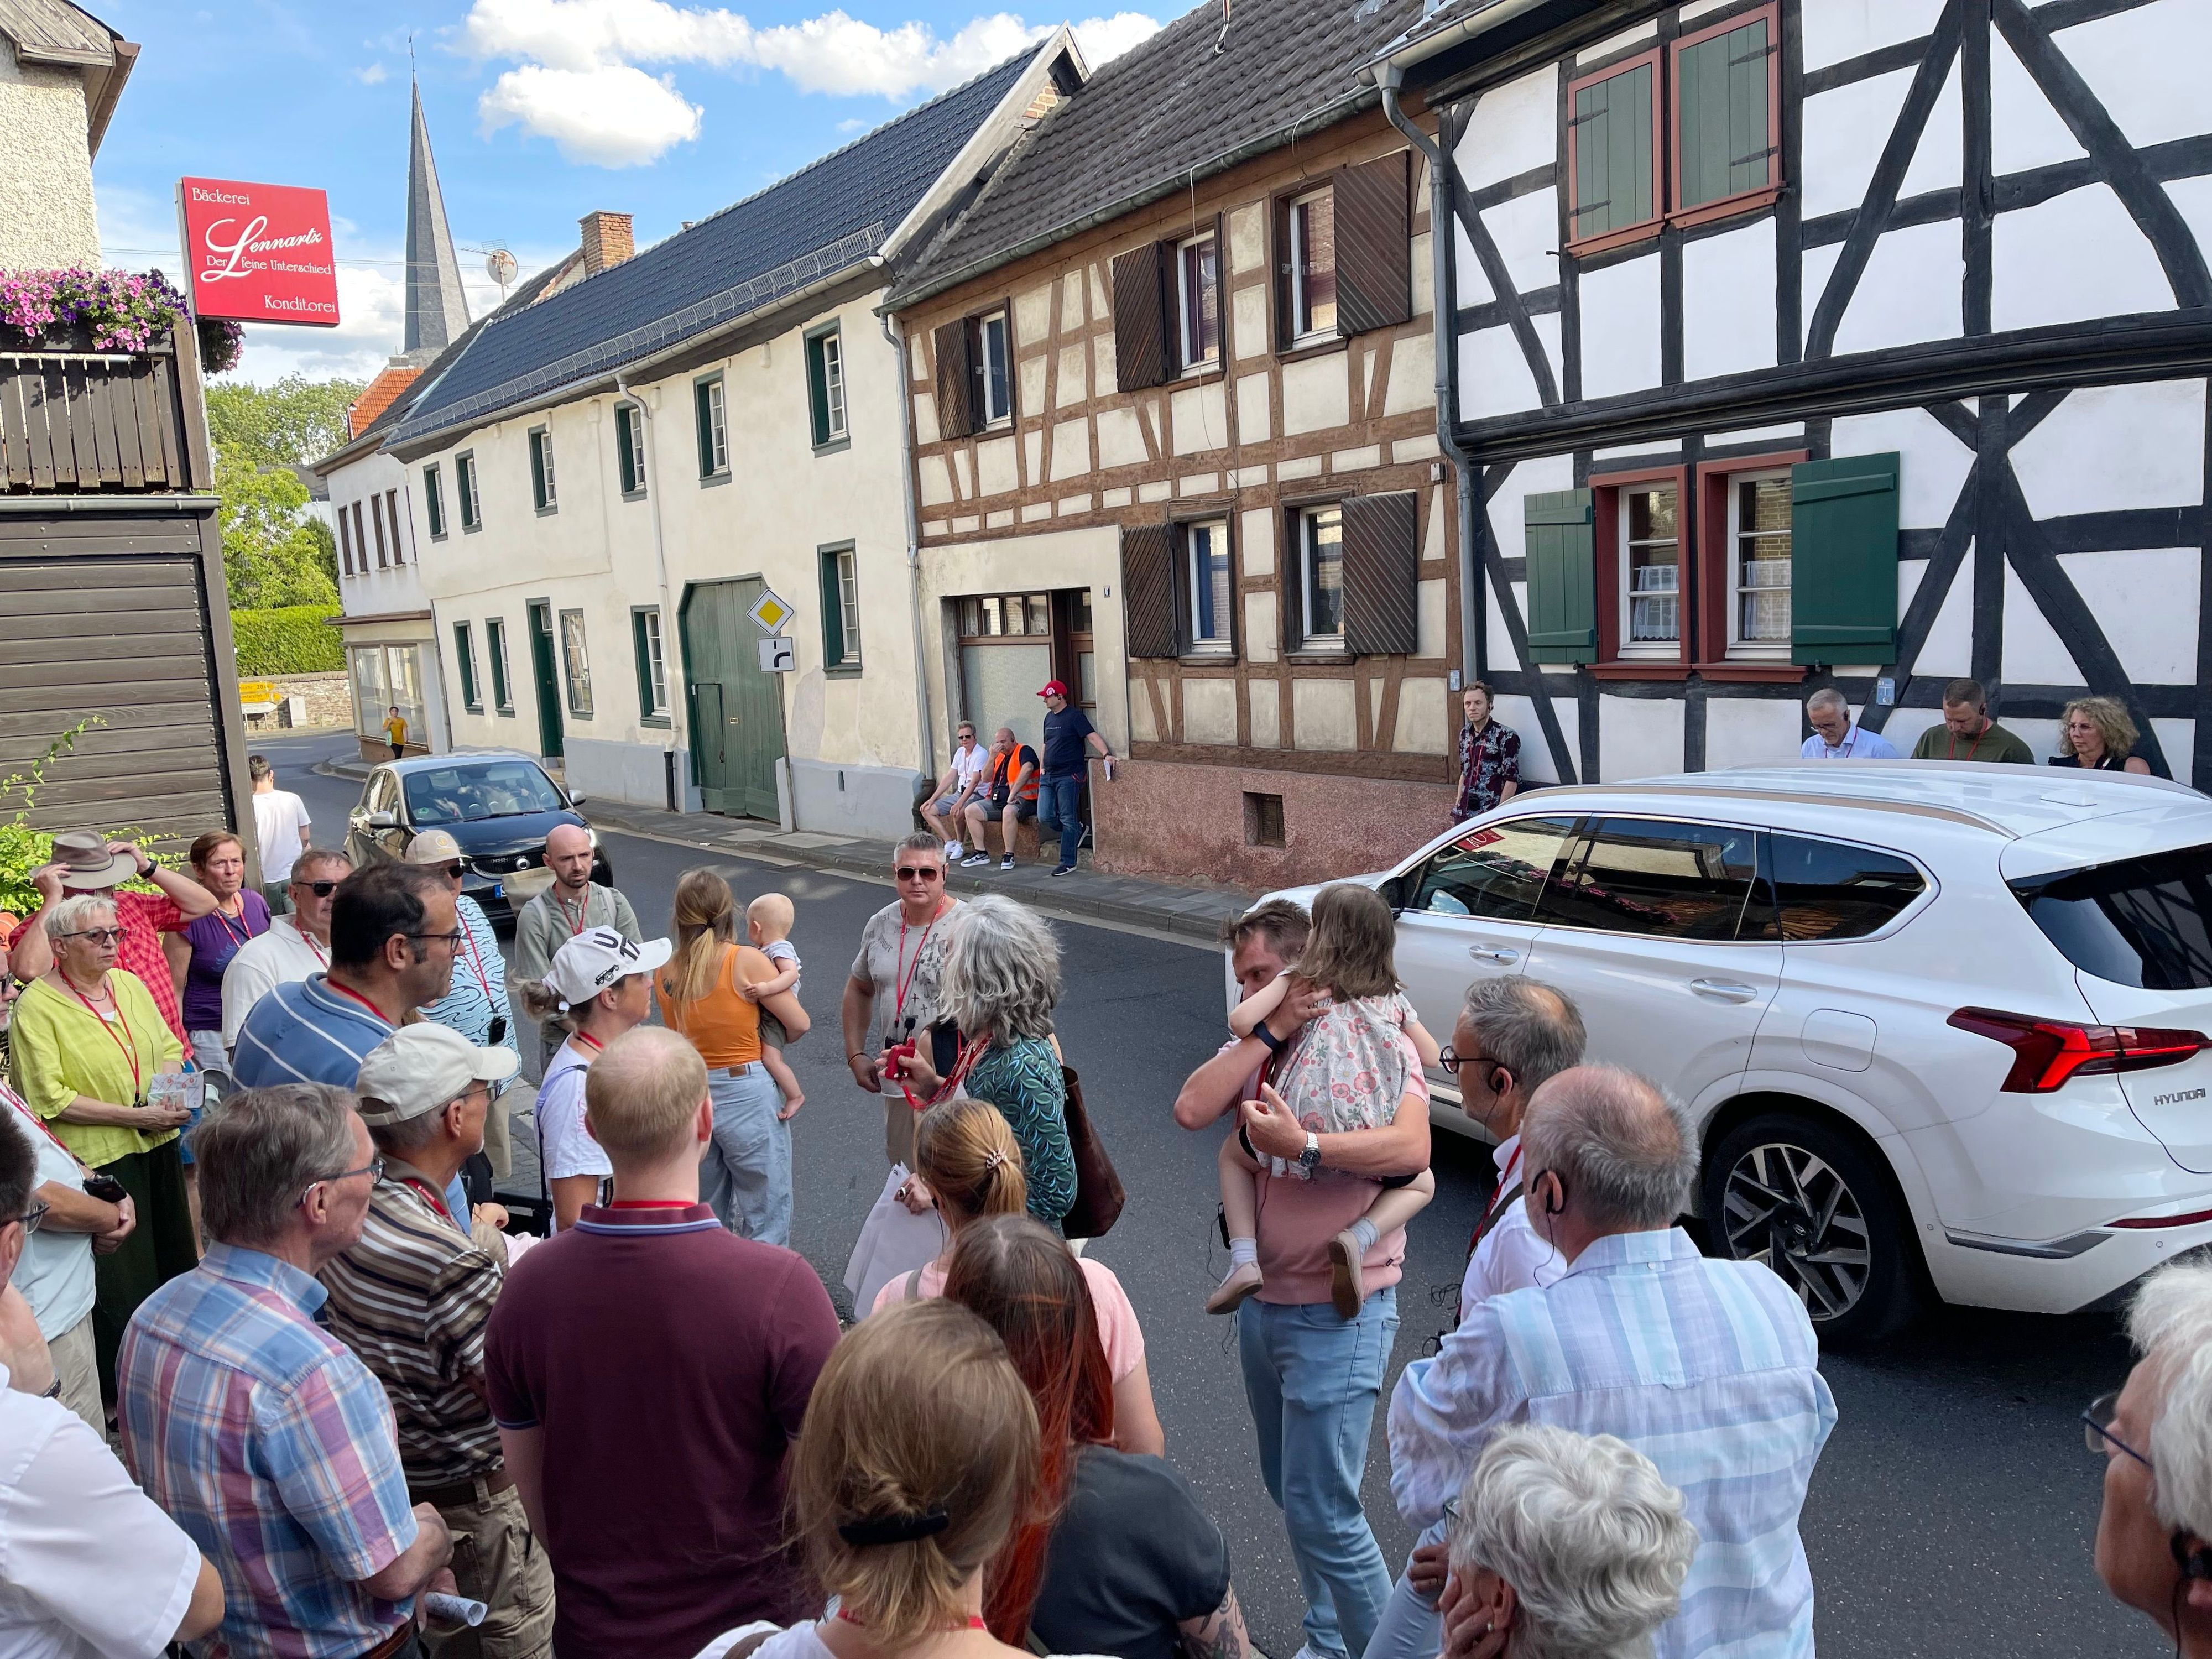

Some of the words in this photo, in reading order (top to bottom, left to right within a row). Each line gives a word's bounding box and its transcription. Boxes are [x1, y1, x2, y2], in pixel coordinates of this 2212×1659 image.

[191, 187, 251, 205] Bäckerei
[200, 215, 323, 283] Lennartz
[206, 255, 227, 267] Der
[241, 257, 267, 270] feine
[270, 259, 332, 275] Unterschied
[264, 295, 336, 313] Konditorei
[619, 937, 640, 961] 17
[2153, 1088, 2206, 1106] HYUNDAI
